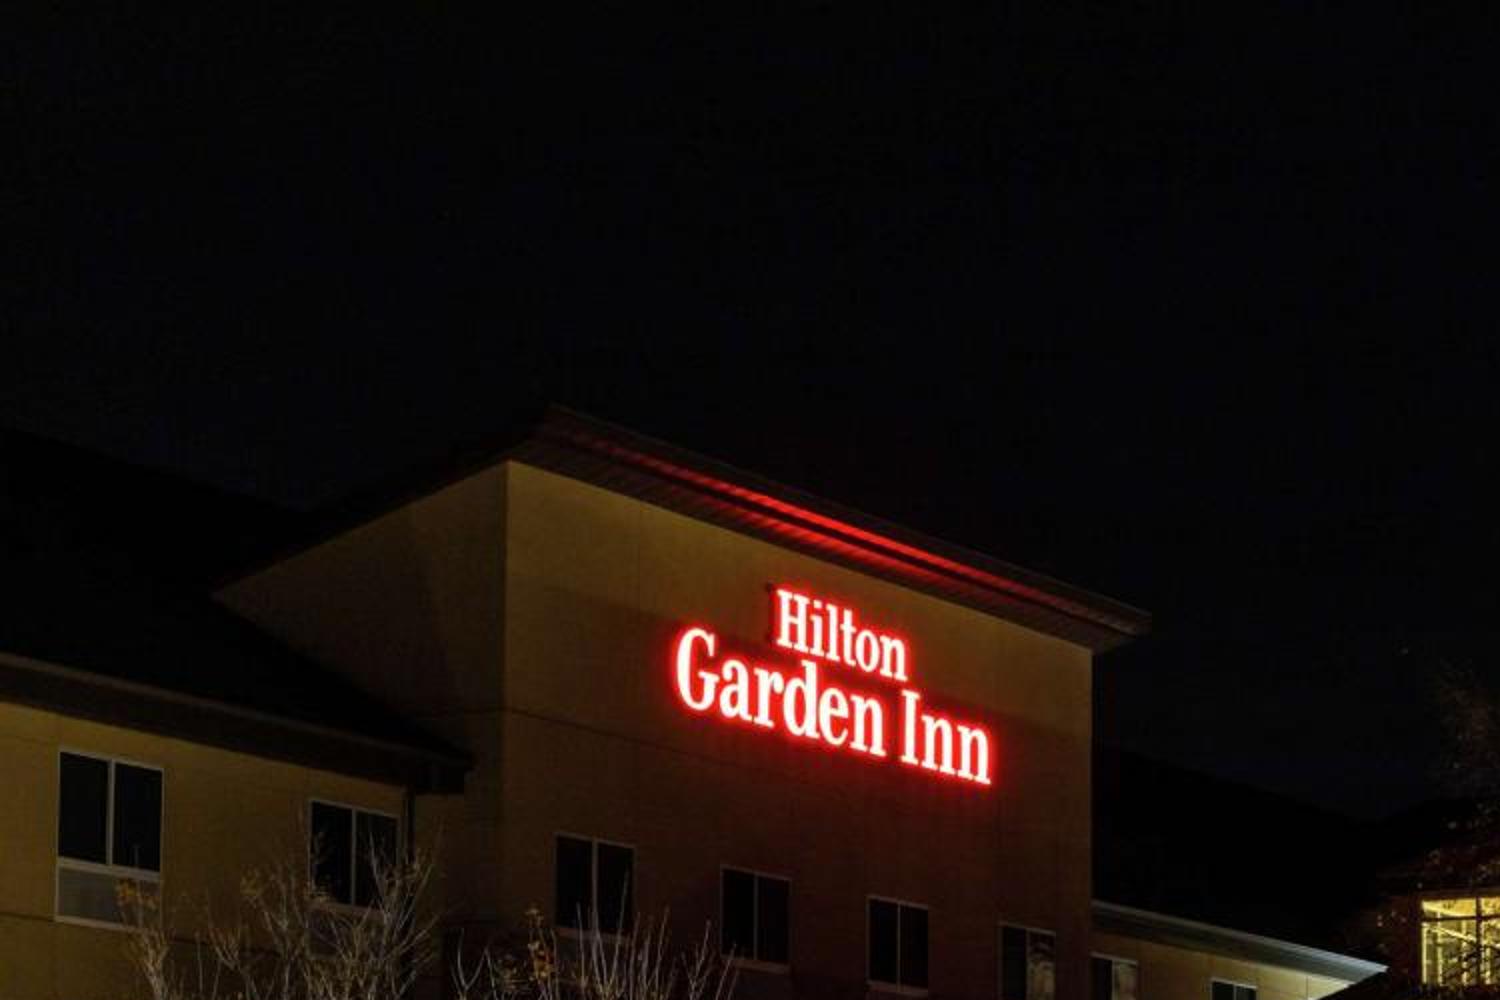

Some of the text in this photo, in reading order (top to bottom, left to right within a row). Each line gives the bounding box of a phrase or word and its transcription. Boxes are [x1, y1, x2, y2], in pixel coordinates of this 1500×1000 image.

[776, 588, 908, 682] Hilton
[676, 627, 992, 785] Garden Inn
